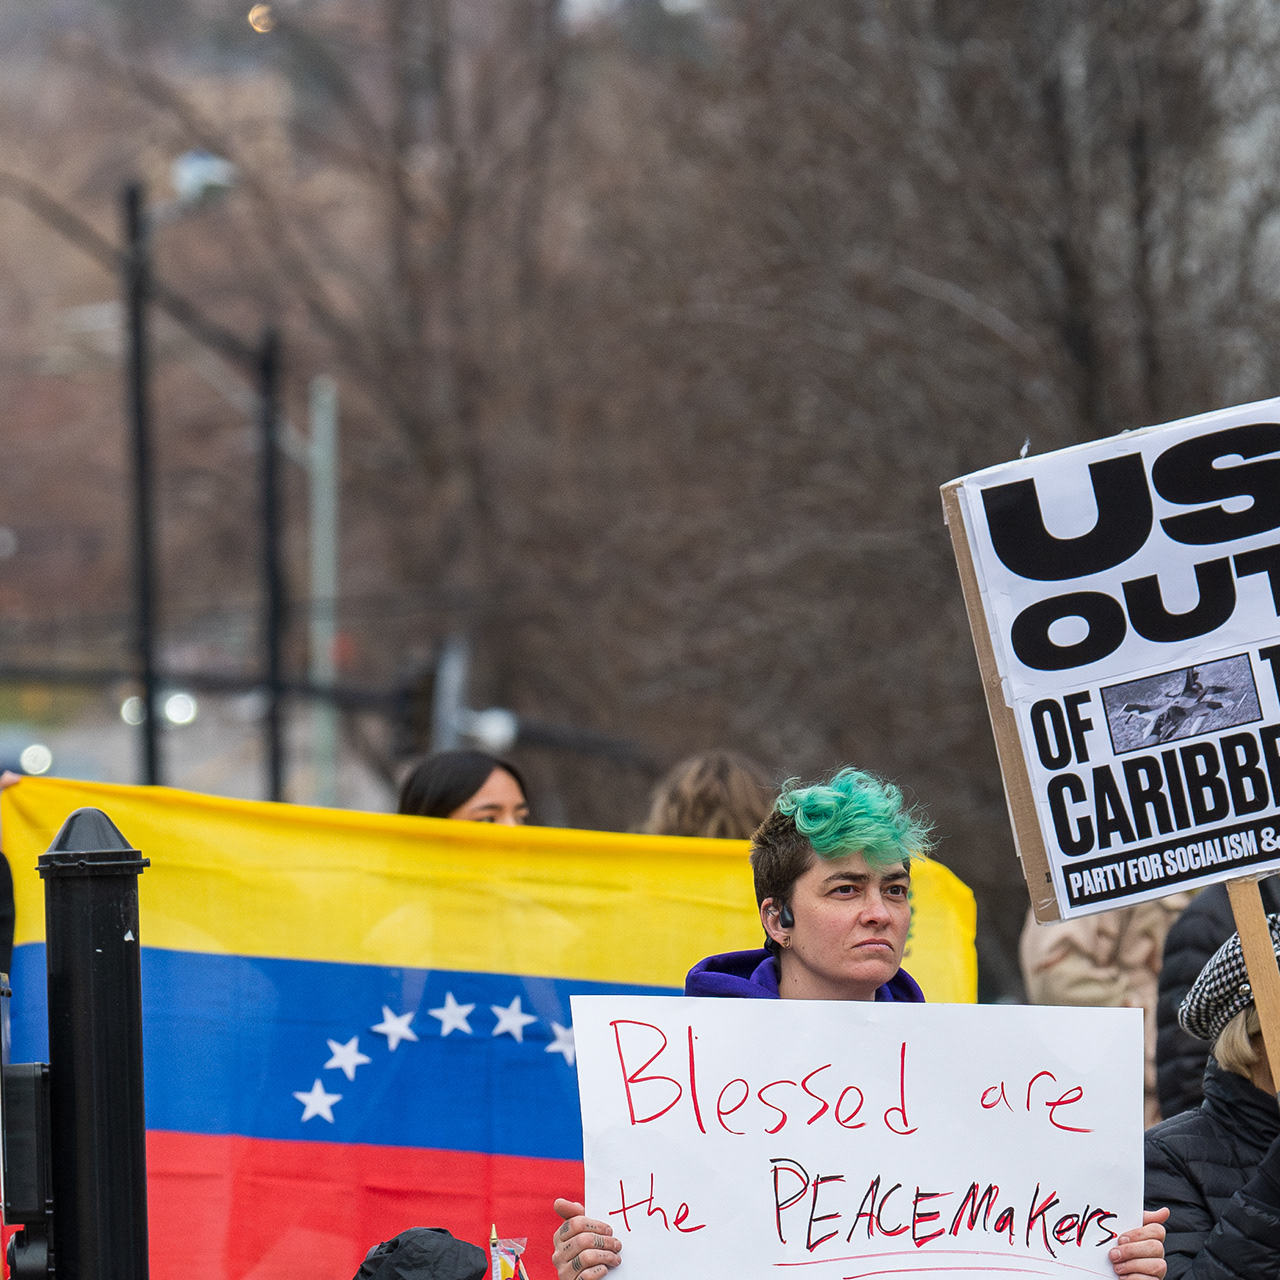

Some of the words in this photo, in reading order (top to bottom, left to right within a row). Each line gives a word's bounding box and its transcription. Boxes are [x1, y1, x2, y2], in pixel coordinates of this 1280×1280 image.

[1029, 690, 1095, 771] OF
[1068, 863, 1127, 899] PARTY
[1127, 853, 1164, 888] FOR
[1164, 829, 1259, 879] SOCIALISM
[609, 1019, 919, 1136] Blessed
[979, 1070, 1096, 1134] are
[608, 1172, 707, 1235] the
